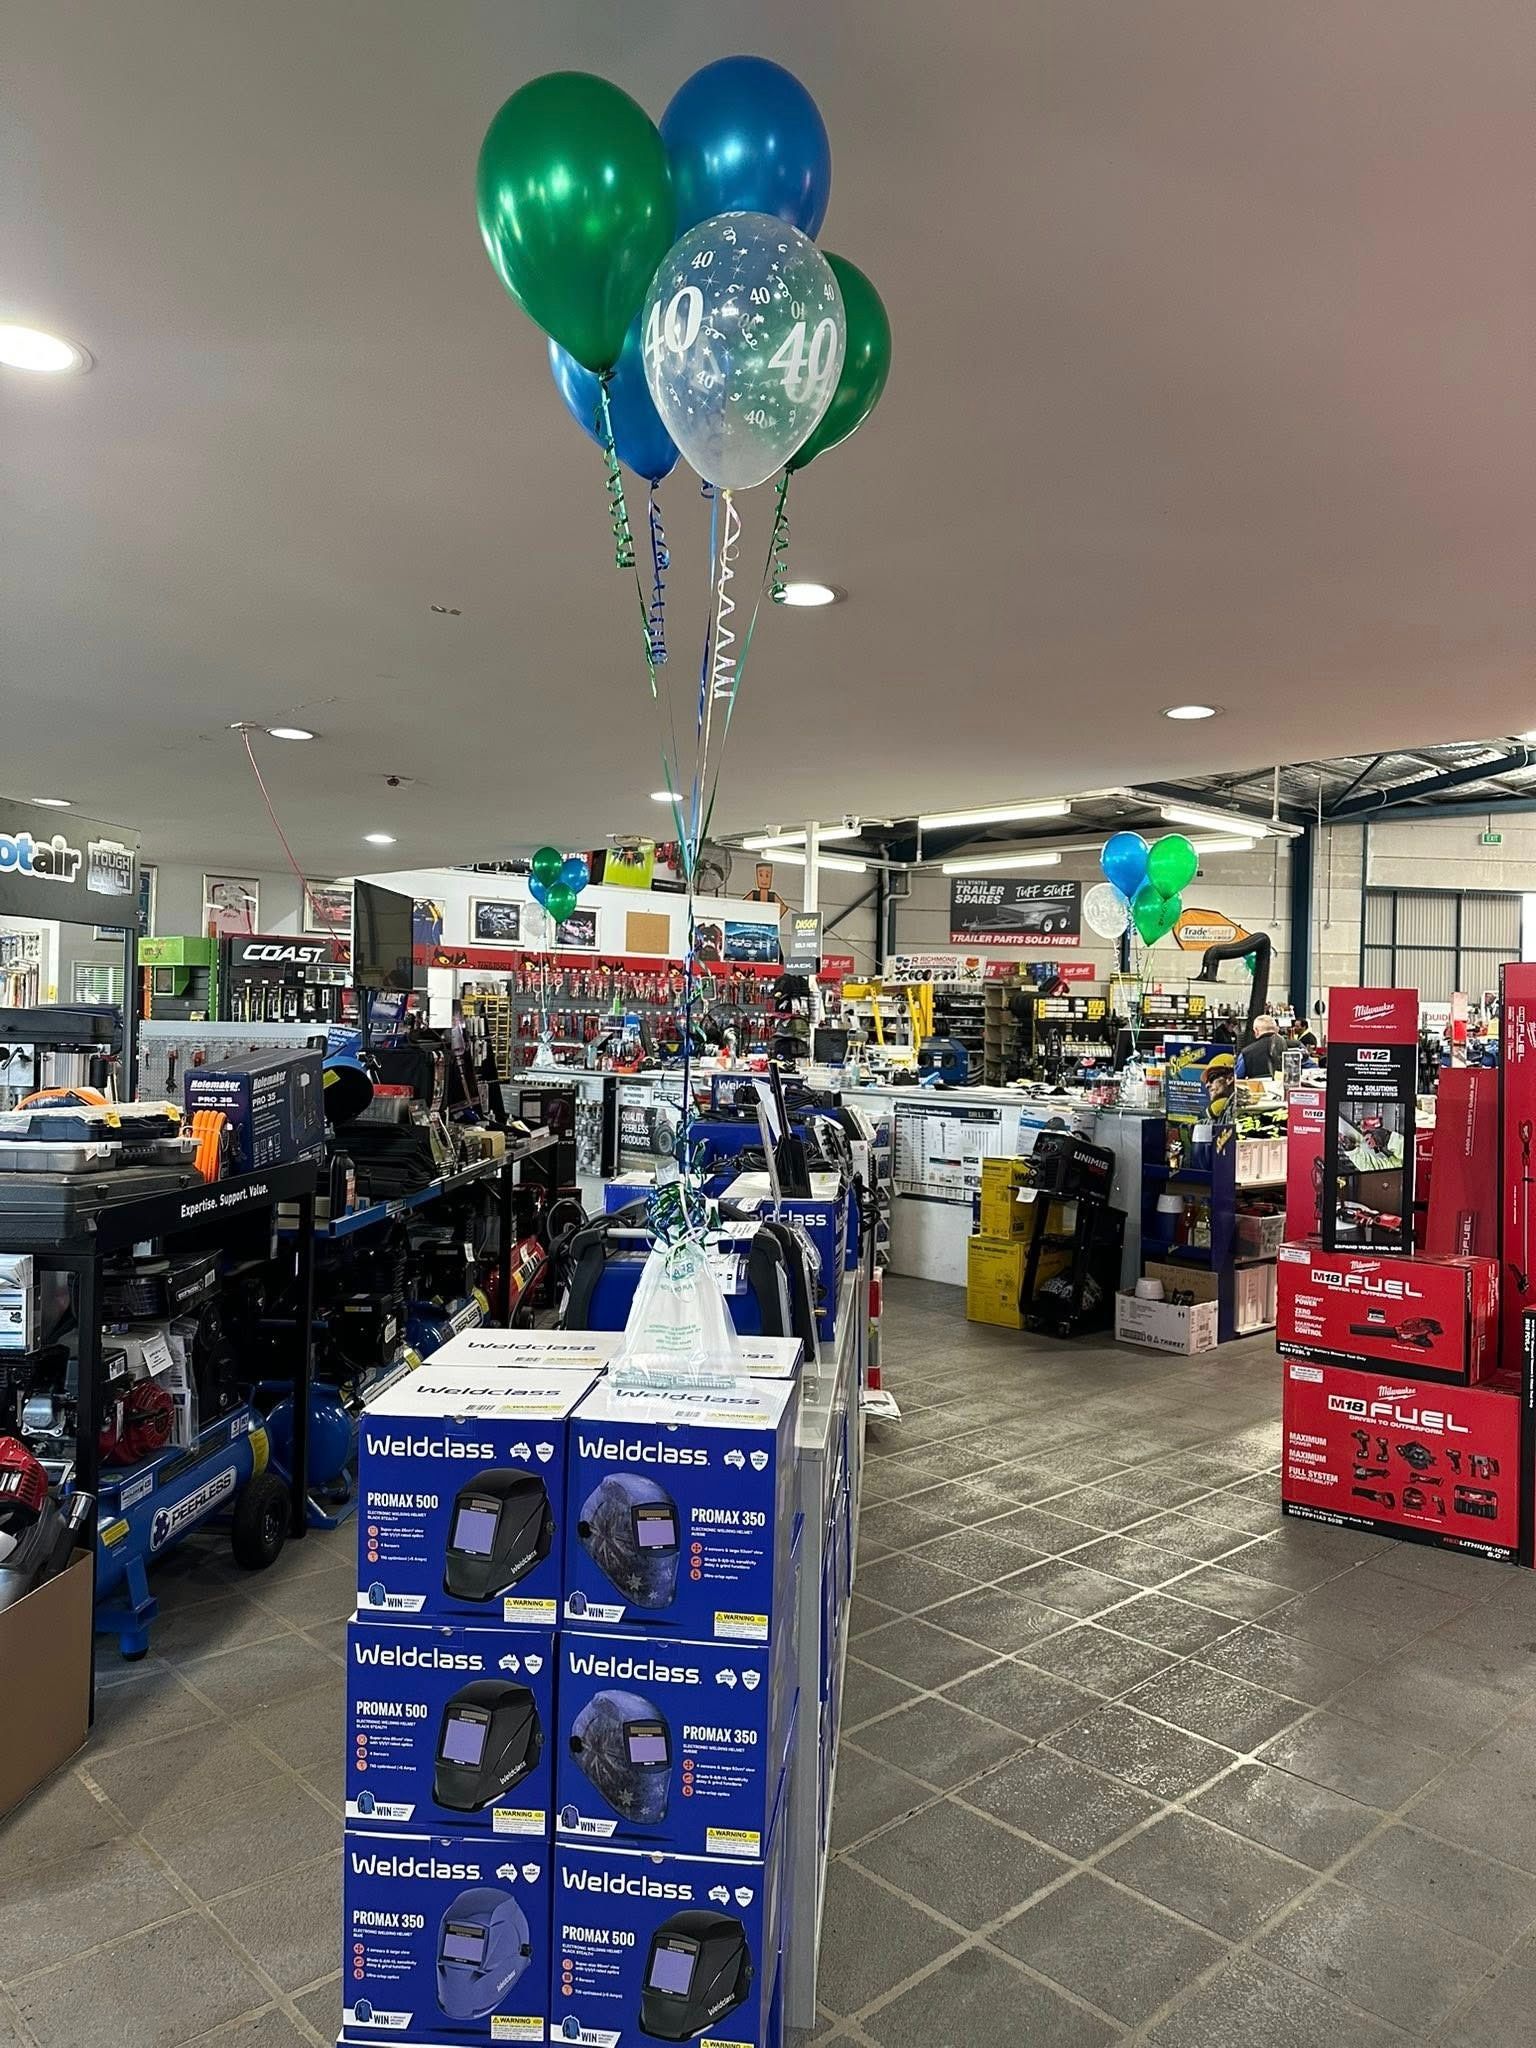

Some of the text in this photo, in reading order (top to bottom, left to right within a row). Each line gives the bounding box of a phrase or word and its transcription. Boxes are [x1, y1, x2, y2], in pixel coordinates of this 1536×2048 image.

[691, 251, 714, 269] 40
[750, 287, 770, 305] 40
[824, 284, 835, 301] 40
[645, 286, 703, 368] 40
[767, 318, 837, 385] 40
[696, 371, 716, 389] 40
[93, 851, 130, 871] TOUGH
[956, 885, 1005, 895] TRAILER
[955, 895, 1002, 905] SPARES
[795, 919, 818, 929] DIGGA
[952, 934, 1078, 945] TRAILER PARTS SOLD HERE
[243, 944, 326, 963] COAST
[1352, 1003, 1395, 1018] Milwaukee
[1359, 1051, 1389, 1060] M12
[191, 1080, 240, 1089] Holemaker
[253, 1071, 287, 1090] Holemaker
[252, 1096, 266, 1107] PRO
[267, 1092, 276, 1102] 35
[621, 1111, 645, 1122] QUALITY
[621, 1123, 649, 1135] PEERLESS
[620, 1134, 651, 1146] PRODUCTS
[1074, 1151, 1110, 1171] UNIMIG
[180, 1182, 269, 1219] Expertise. Support. Value.
[1350, 1260, 1381, 1270] Milwaukee
[1313, 1272, 1423, 1298] M18 FUEL
[1295, 1327, 1323, 1337] CONTROL
[467, 1341, 597, 1351] Weldclass
[416, 1385, 561, 1396] Weldclass
[615, 1389, 761, 1405] Weldclass
[1377, 1385, 1417, 1397] Milwaukee
[1330, 1398, 1469, 1433] M18 FUEL
[1349, 1415, 1377, 1424] DRIVEN
[1289, 1432, 1327, 1446] MAXIMUM
[1289, 1440, 1312, 1448] POWER
[1289, 1449, 1327, 1463] MAXIMUM
[1289, 1466, 1339, 1483] FULL SYSTEM
[1289, 1473, 1334, 1486] COMPATIBILITY
[171, 1473, 231, 1526] PEERLESS
[367, 1492, 439, 1509] PROMAX 500
[691, 1508, 766, 1527] PROMAX 350
[388, 1598, 403, 1608] WIN
[588, 1607, 604, 1618] WIN
[723, 1614, 755, 1622] WARNING
[356, 1701, 428, 1718] PROMAX 500
[683, 1726, 757, 1745] PROMAX 350
[376, 1806, 392, 1817] WIN
[502, 1810, 532, 1818] WARNING
[580, 1821, 596, 1832] WIN
[715, 1830, 747, 1838] WARNING
[353, 1910, 424, 1928] PROMAX 350
[562, 1925, 635, 1946] PROMAX 500
[374, 2015, 390, 2025] WIN
[581, 2032, 597, 2043] WIN
